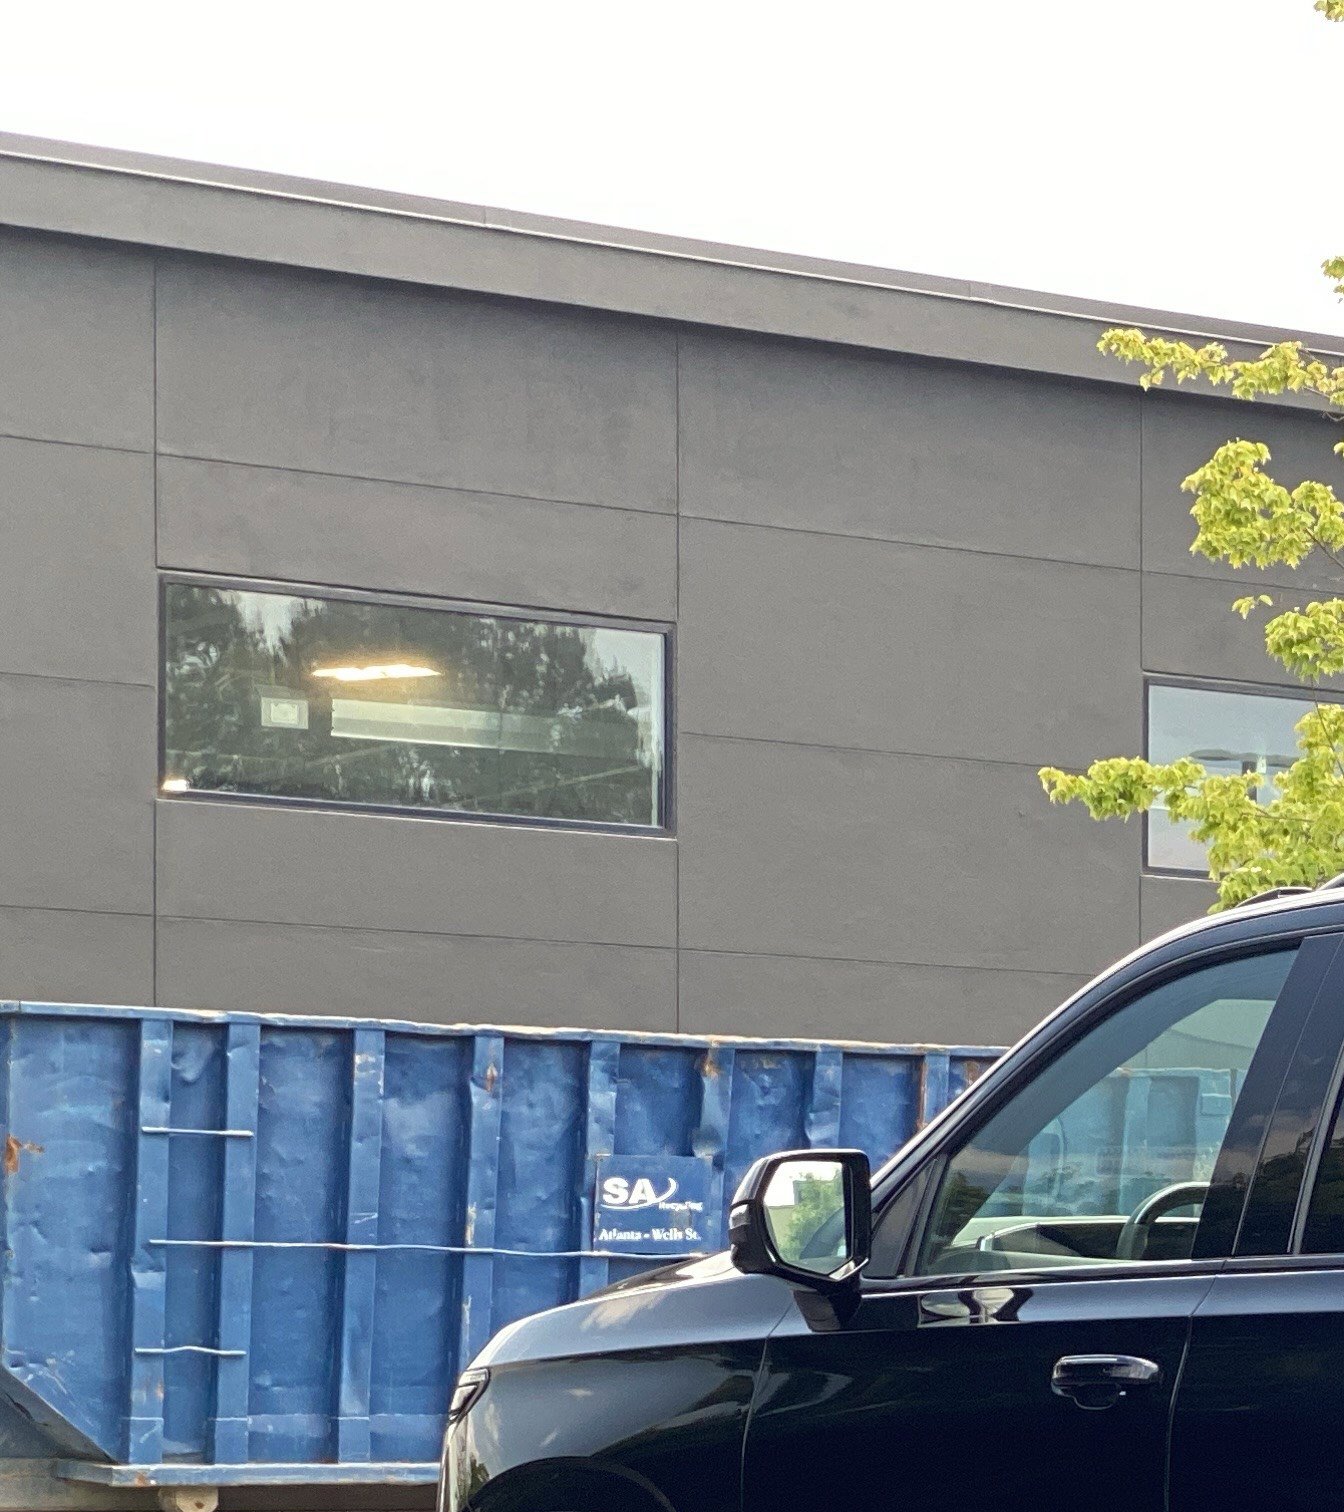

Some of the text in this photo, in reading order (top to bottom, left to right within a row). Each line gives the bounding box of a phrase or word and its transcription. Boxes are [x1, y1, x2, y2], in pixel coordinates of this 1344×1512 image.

[602, 1176, 657, 1205] SA
[599, 1228, 642, 1241] Atlanta
[651, 1227, 683, 1241] Wells
